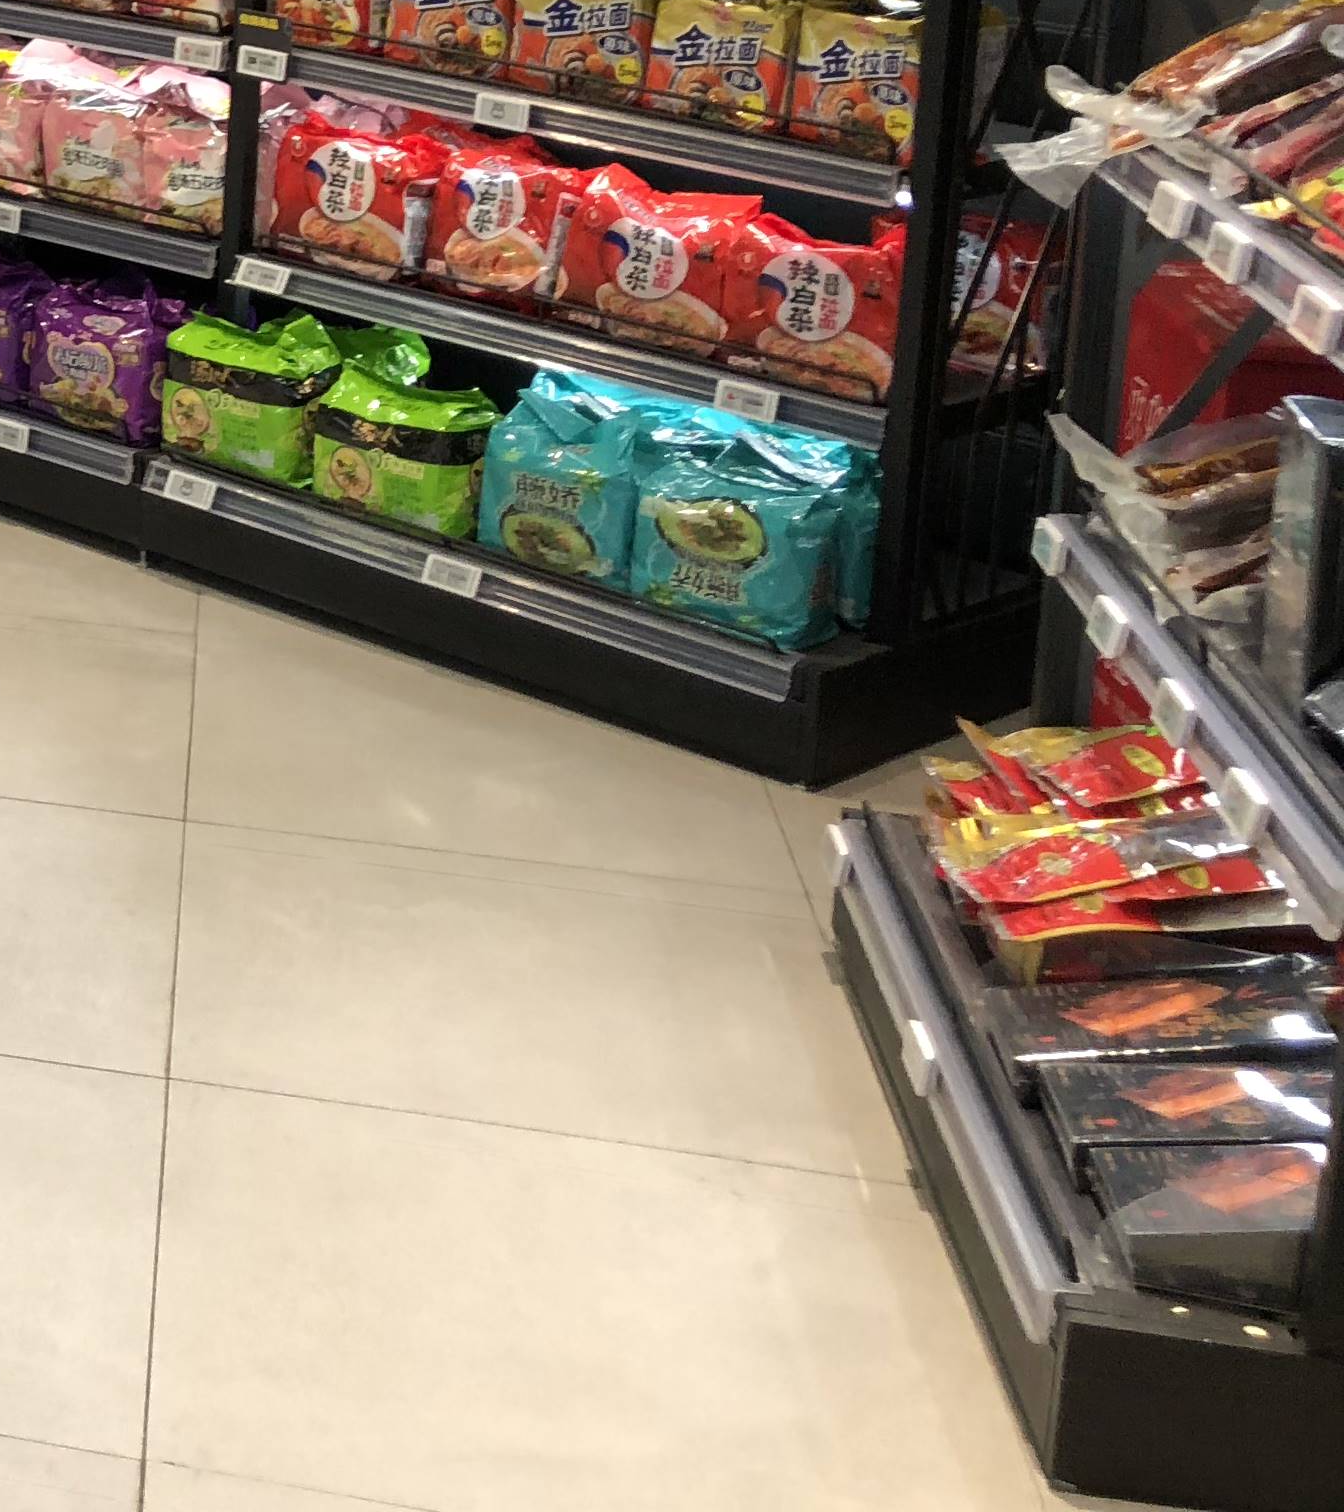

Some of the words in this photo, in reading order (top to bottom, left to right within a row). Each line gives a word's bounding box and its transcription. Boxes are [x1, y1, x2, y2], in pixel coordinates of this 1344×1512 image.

[672, 22, 764, 68] 金拉面
[817, 38, 907, 84] 金拉面
